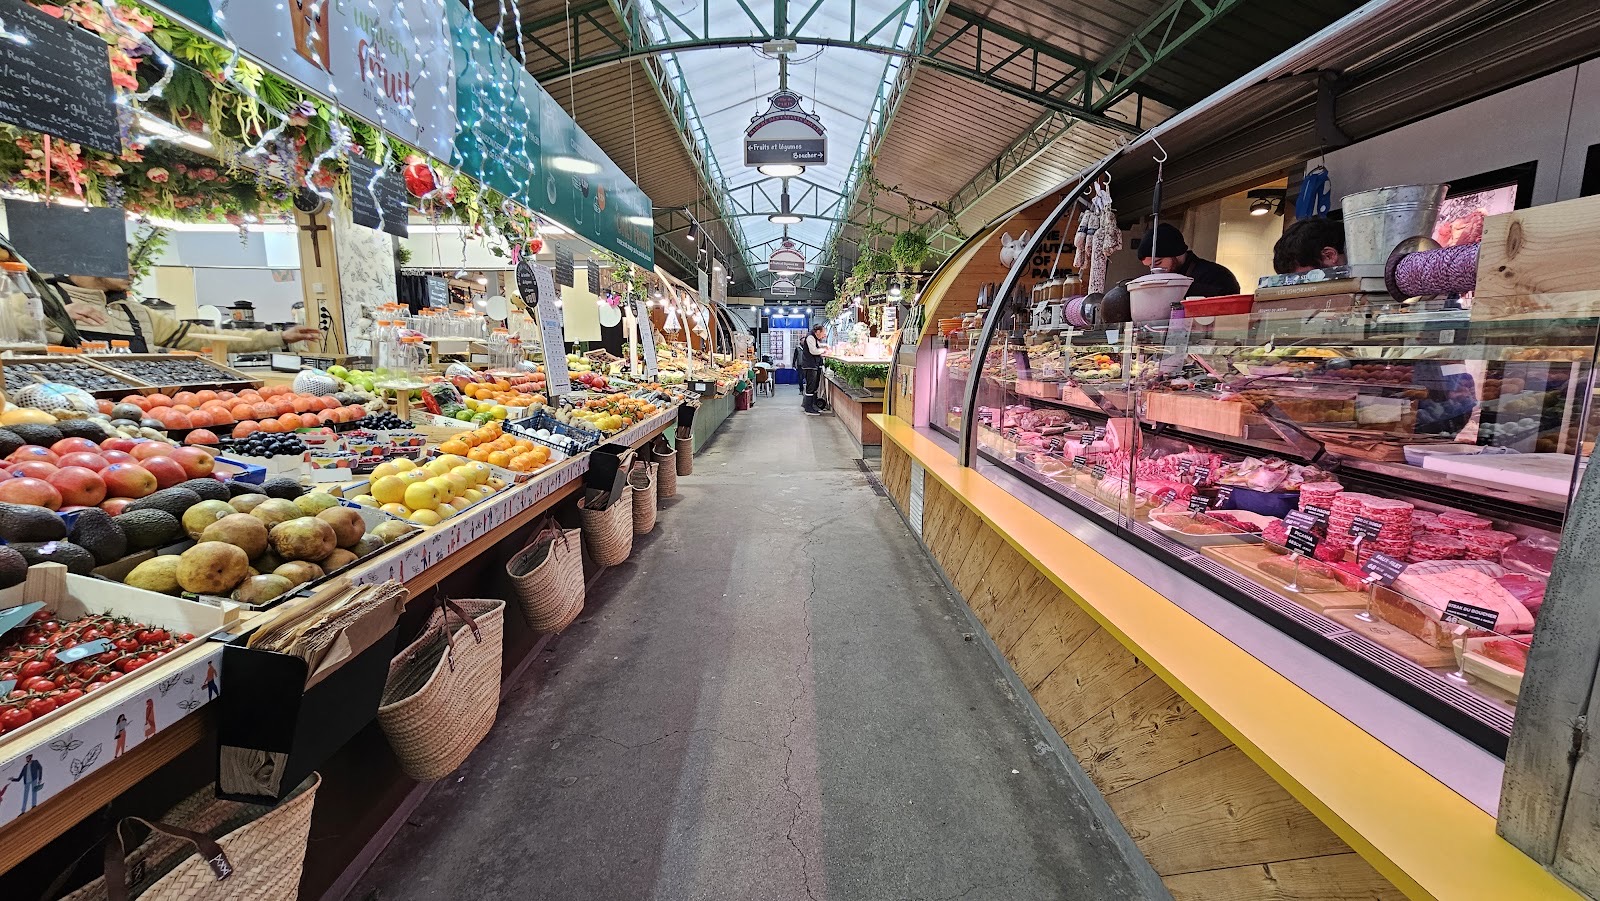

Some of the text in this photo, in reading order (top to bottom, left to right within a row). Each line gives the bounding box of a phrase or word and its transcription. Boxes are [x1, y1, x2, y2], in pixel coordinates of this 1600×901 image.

[357, 38, 411, 106] fruit
[363, 88, 372, 101] All
[753, 143, 769, 151] Fruits
[792, 151, 817, 159] Boucher
[1033, 256, 1050, 265] OF
[1286, 286, 1317, 295] IGNORANTS
[1471, 608, 1498, 618] BOUCHER
